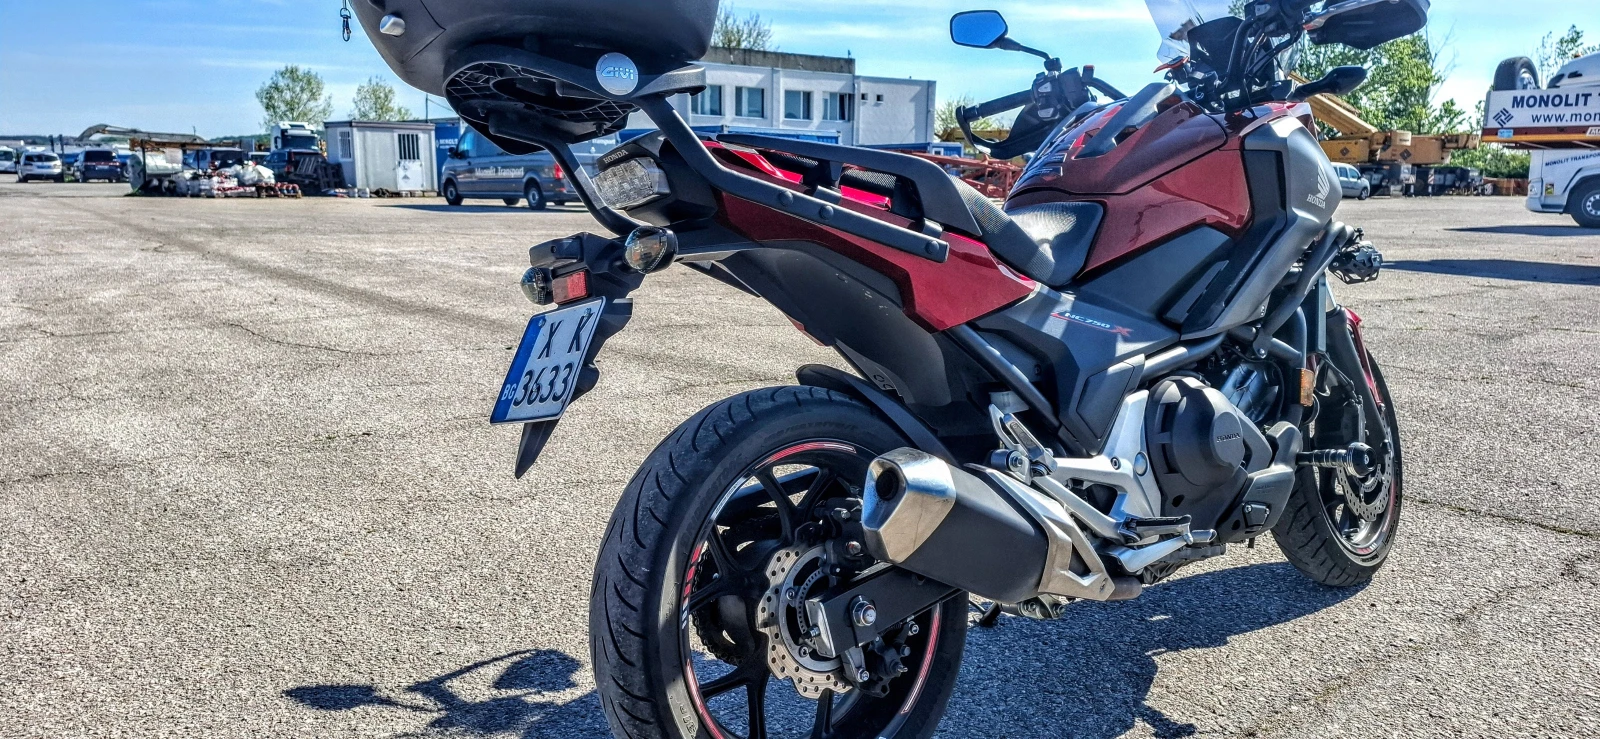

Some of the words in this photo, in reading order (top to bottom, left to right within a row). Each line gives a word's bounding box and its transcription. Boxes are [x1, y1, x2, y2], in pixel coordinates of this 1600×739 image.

[1512, 93, 1592, 109] MONOLIT
[603, 150, 629, 164] HONDA
[1545, 157, 1569, 167] MONOLIT
[1307, 194, 1326, 209] HONDA
[501, 383, 517, 400] BG
[513, 362, 573, 406] 3633
